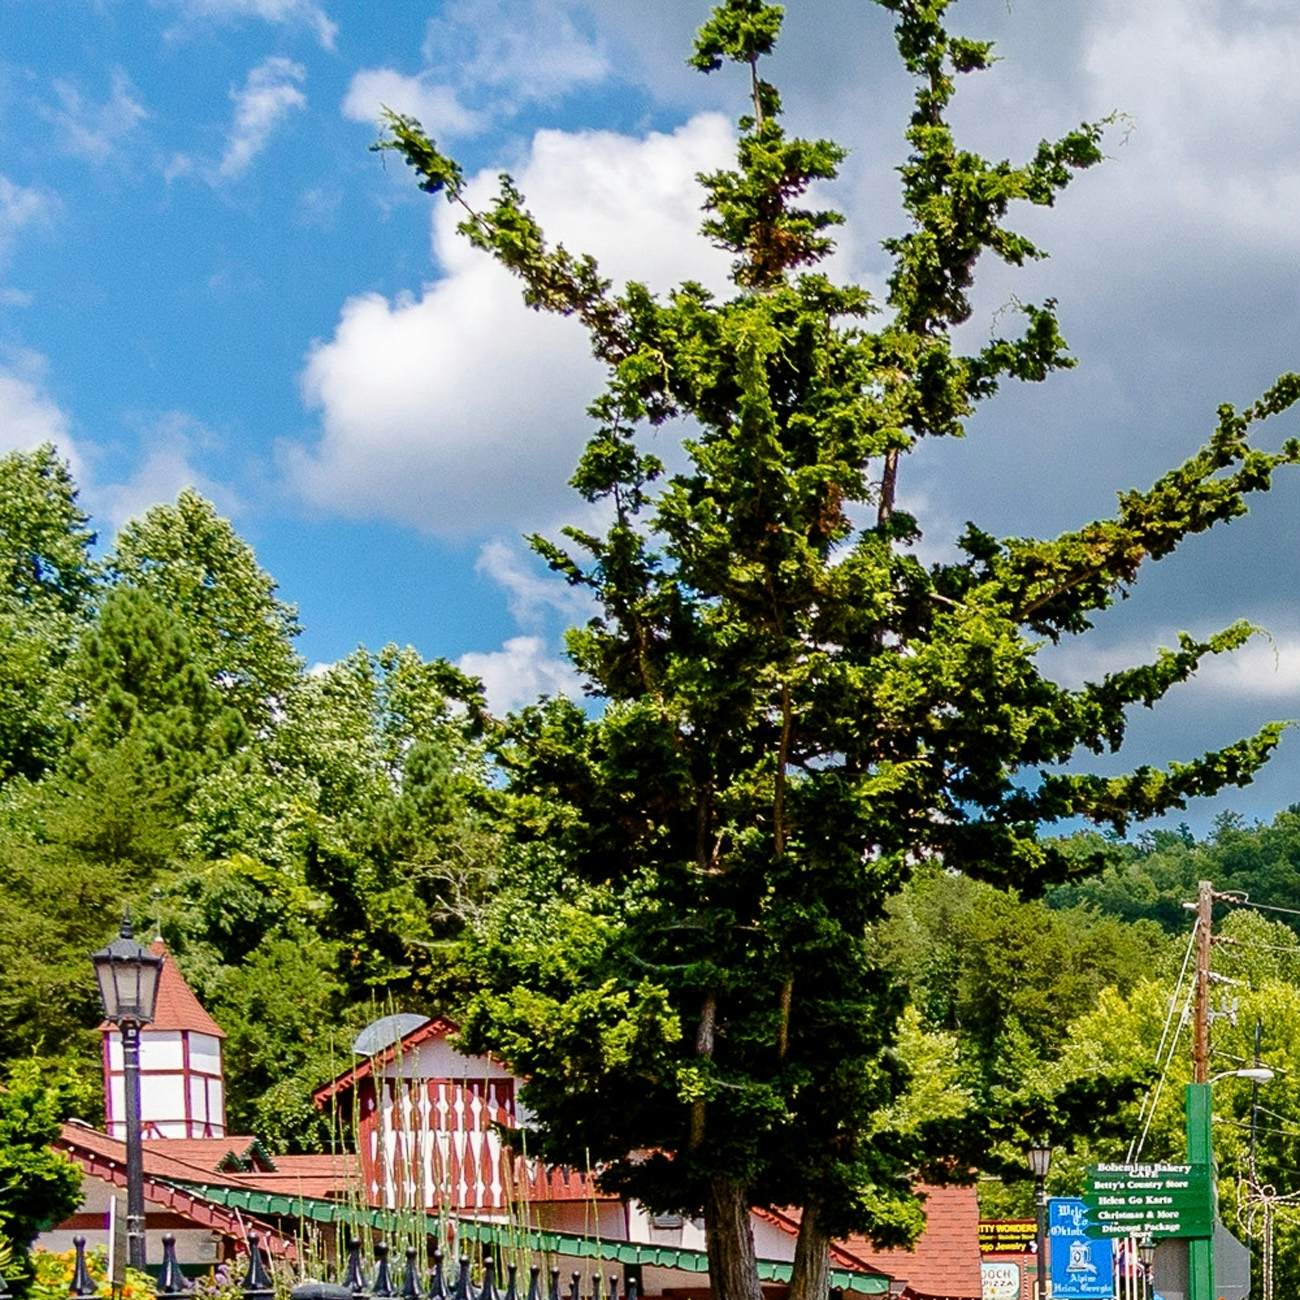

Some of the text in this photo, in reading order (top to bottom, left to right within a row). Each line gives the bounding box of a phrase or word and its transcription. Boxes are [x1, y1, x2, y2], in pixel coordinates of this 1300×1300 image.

[1097, 1162, 1192, 1174] Bohemian Bakery
[1094, 1180, 1189, 1191] Betty's Country Store
[1098, 1195, 1173, 1205] Helen Go Karts
[1098, 1210, 1180, 1220] Christmas & More
[995, 1223, 1038, 1233] WONDERS
[1102, 1222, 1181, 1233] Discount Package
